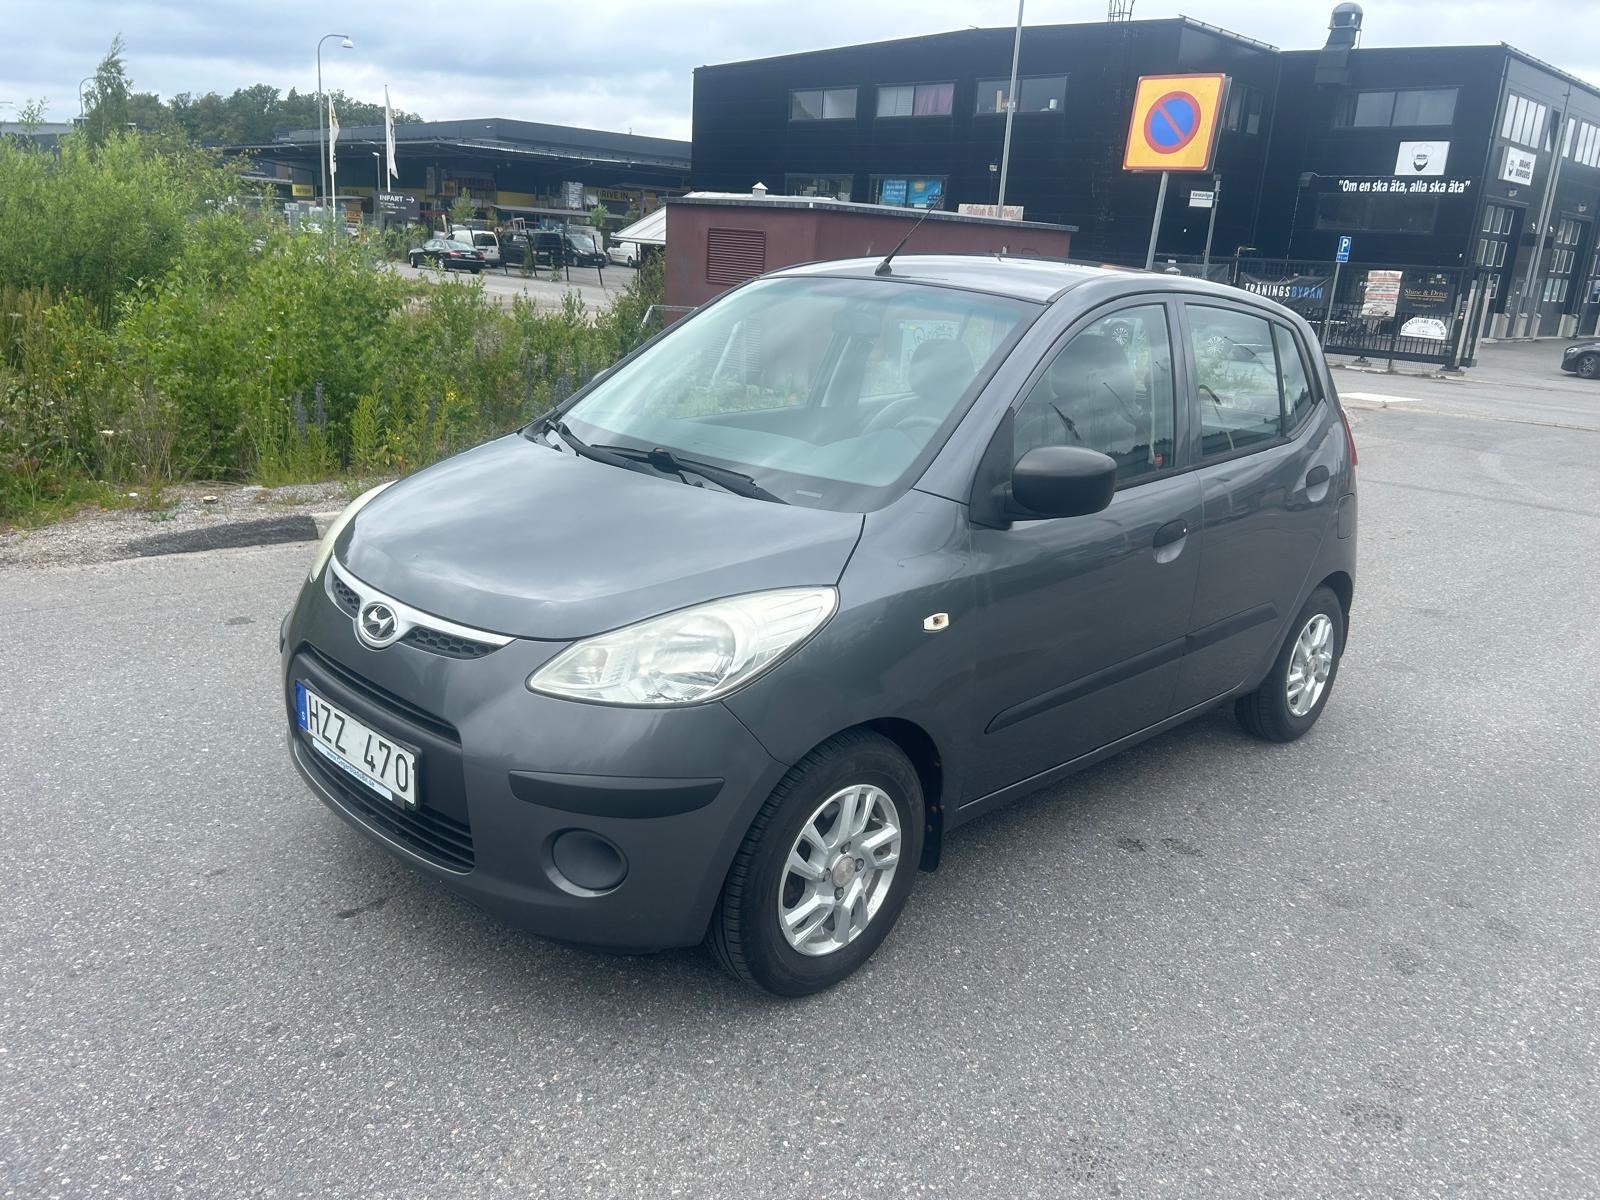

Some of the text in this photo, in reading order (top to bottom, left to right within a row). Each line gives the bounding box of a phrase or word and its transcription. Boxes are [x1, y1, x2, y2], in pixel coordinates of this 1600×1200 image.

[1359, 182, 1370, 192] en
[1372, 180, 1388, 192] ska
[1390, 180, 1408, 194] äta,
[1410, 181, 1428, 193] alla
[1429, 181, 1446, 193] ska
[380, 194, 404, 202] INFART
[620, 190, 629, 201] IN
[1340, 238, 1349, 252] P
[308, 694, 346, 755] HZZ
[364, 734, 408, 792] 470
